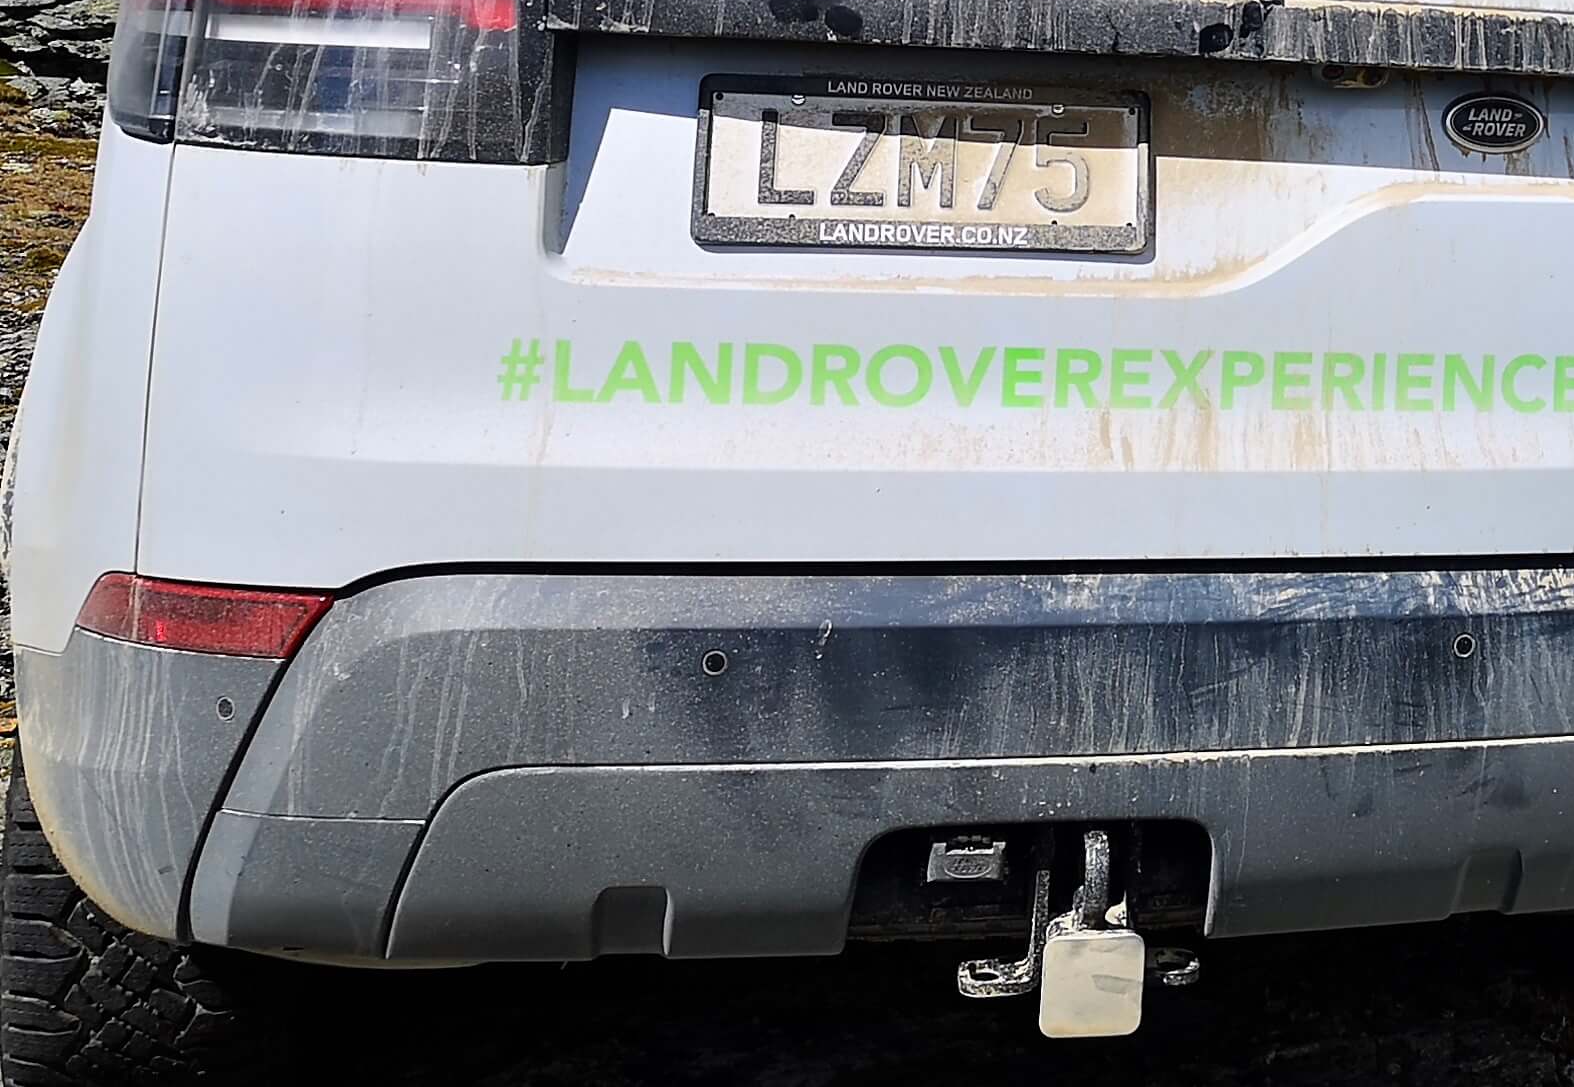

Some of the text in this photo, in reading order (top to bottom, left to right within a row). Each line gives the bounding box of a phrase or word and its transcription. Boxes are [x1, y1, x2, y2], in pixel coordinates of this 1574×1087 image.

[827, 80, 1034, 100] LAND ROVER NEW ZEALAND
[1468, 108, 1513, 122] LAND
[1471, 122, 1527, 137] ROVER
[756, 109, 1092, 213] LZM75
[818, 222, 1029, 246] LANDROVER.CO.NZ
